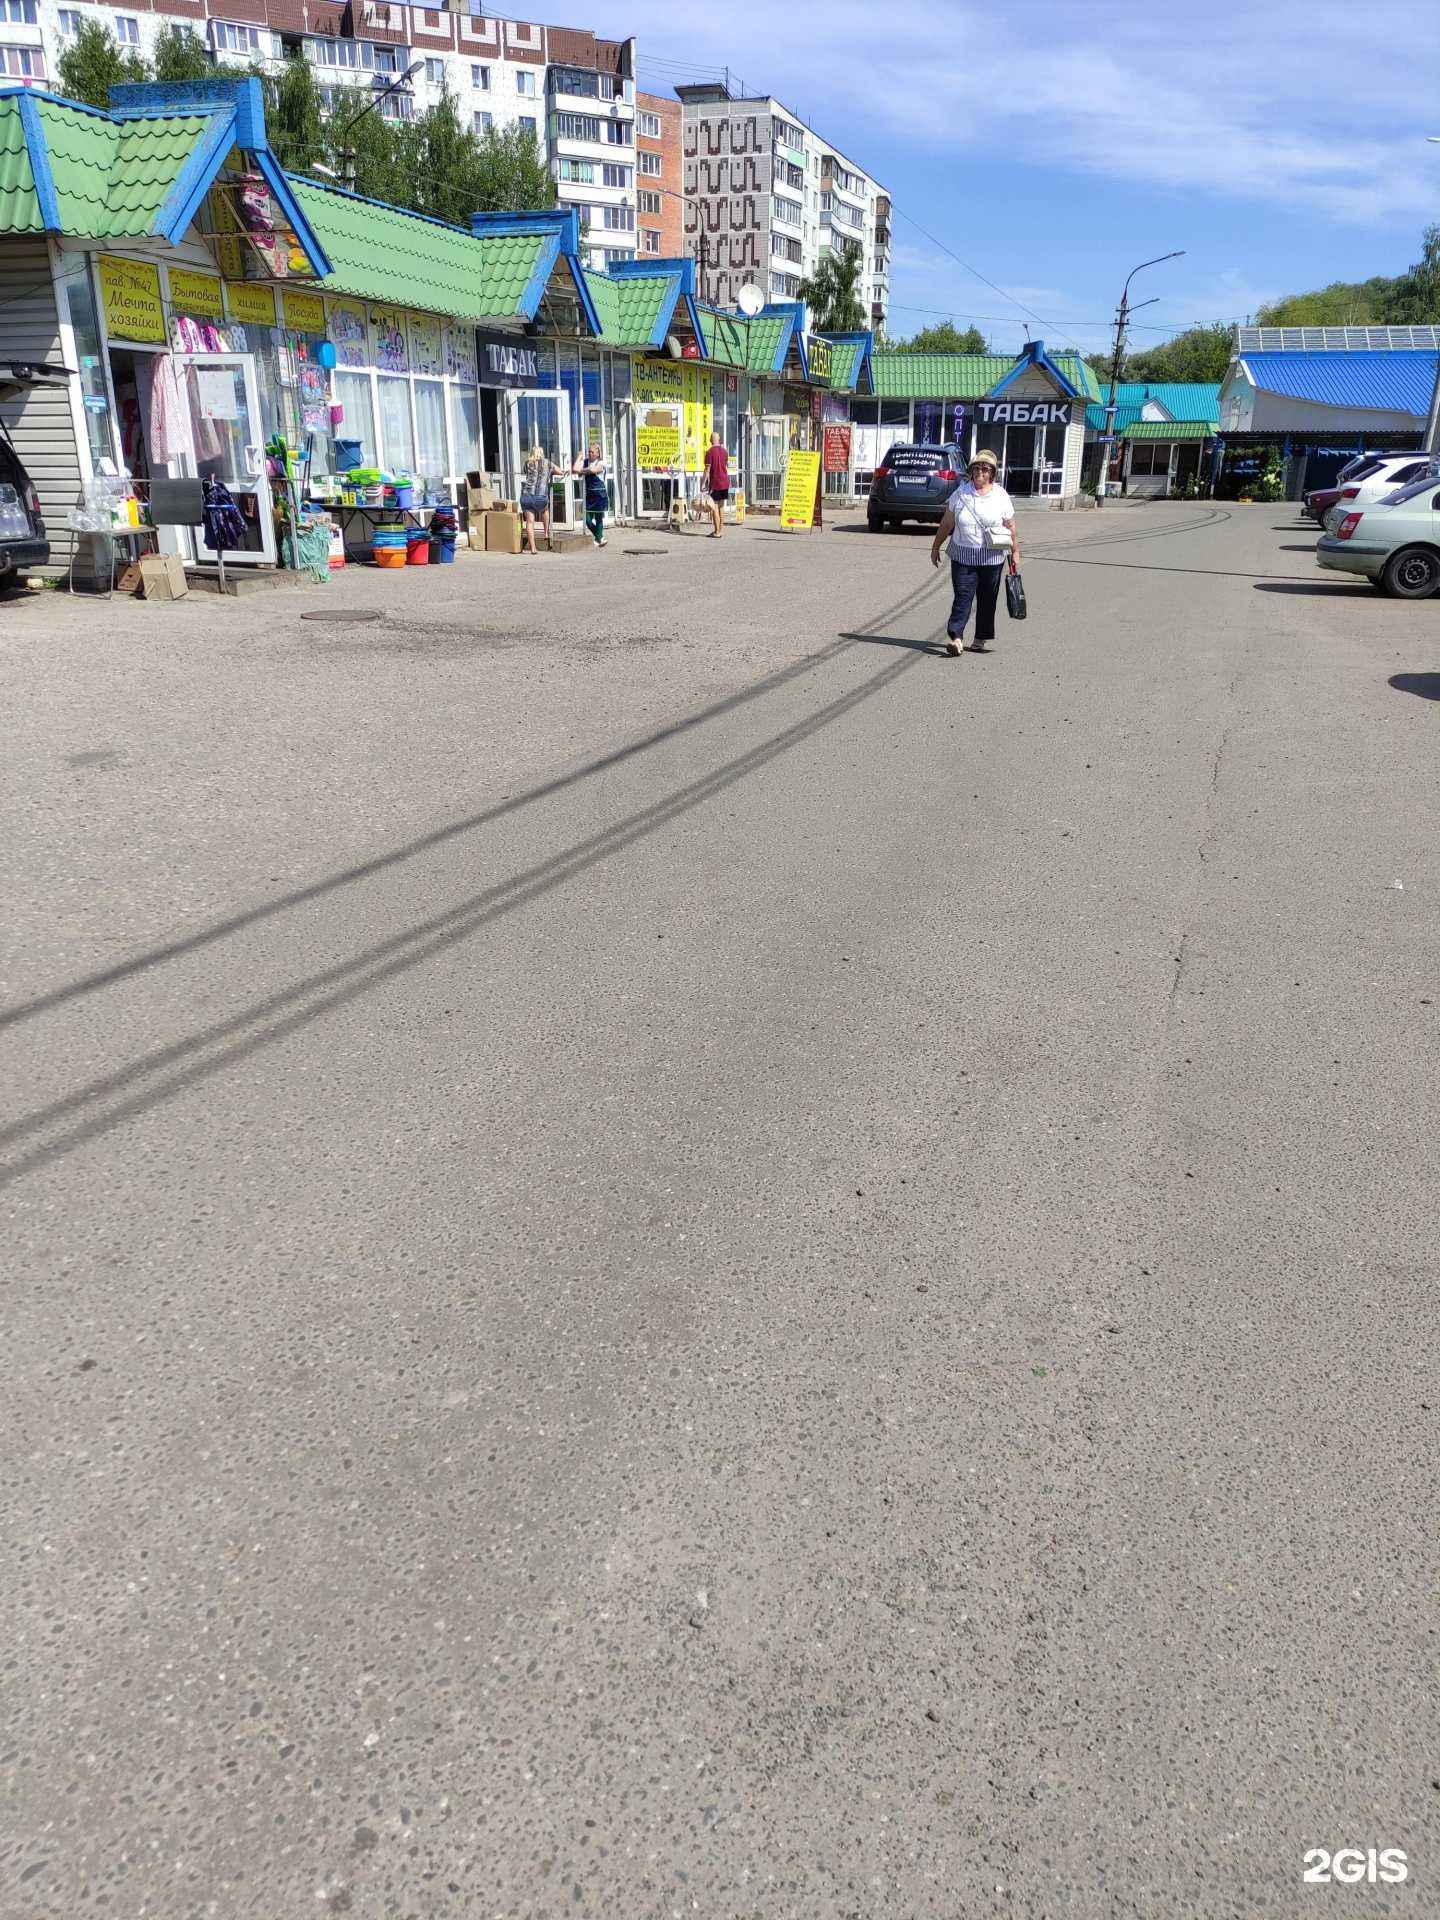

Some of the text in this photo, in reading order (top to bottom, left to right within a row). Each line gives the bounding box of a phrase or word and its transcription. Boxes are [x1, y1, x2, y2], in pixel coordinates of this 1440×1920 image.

[109, 290, 157, 313] Мечта
[172, 281, 219, 303] Бытовая
[110, 313, 160, 330] хозяйки
[288, 303, 320, 321] Посуда
[485, 343, 538, 377] ТАБАК
[808, 344, 832, 378] ТАБАК
[978, 403, 1069, 423] ТАБАК
